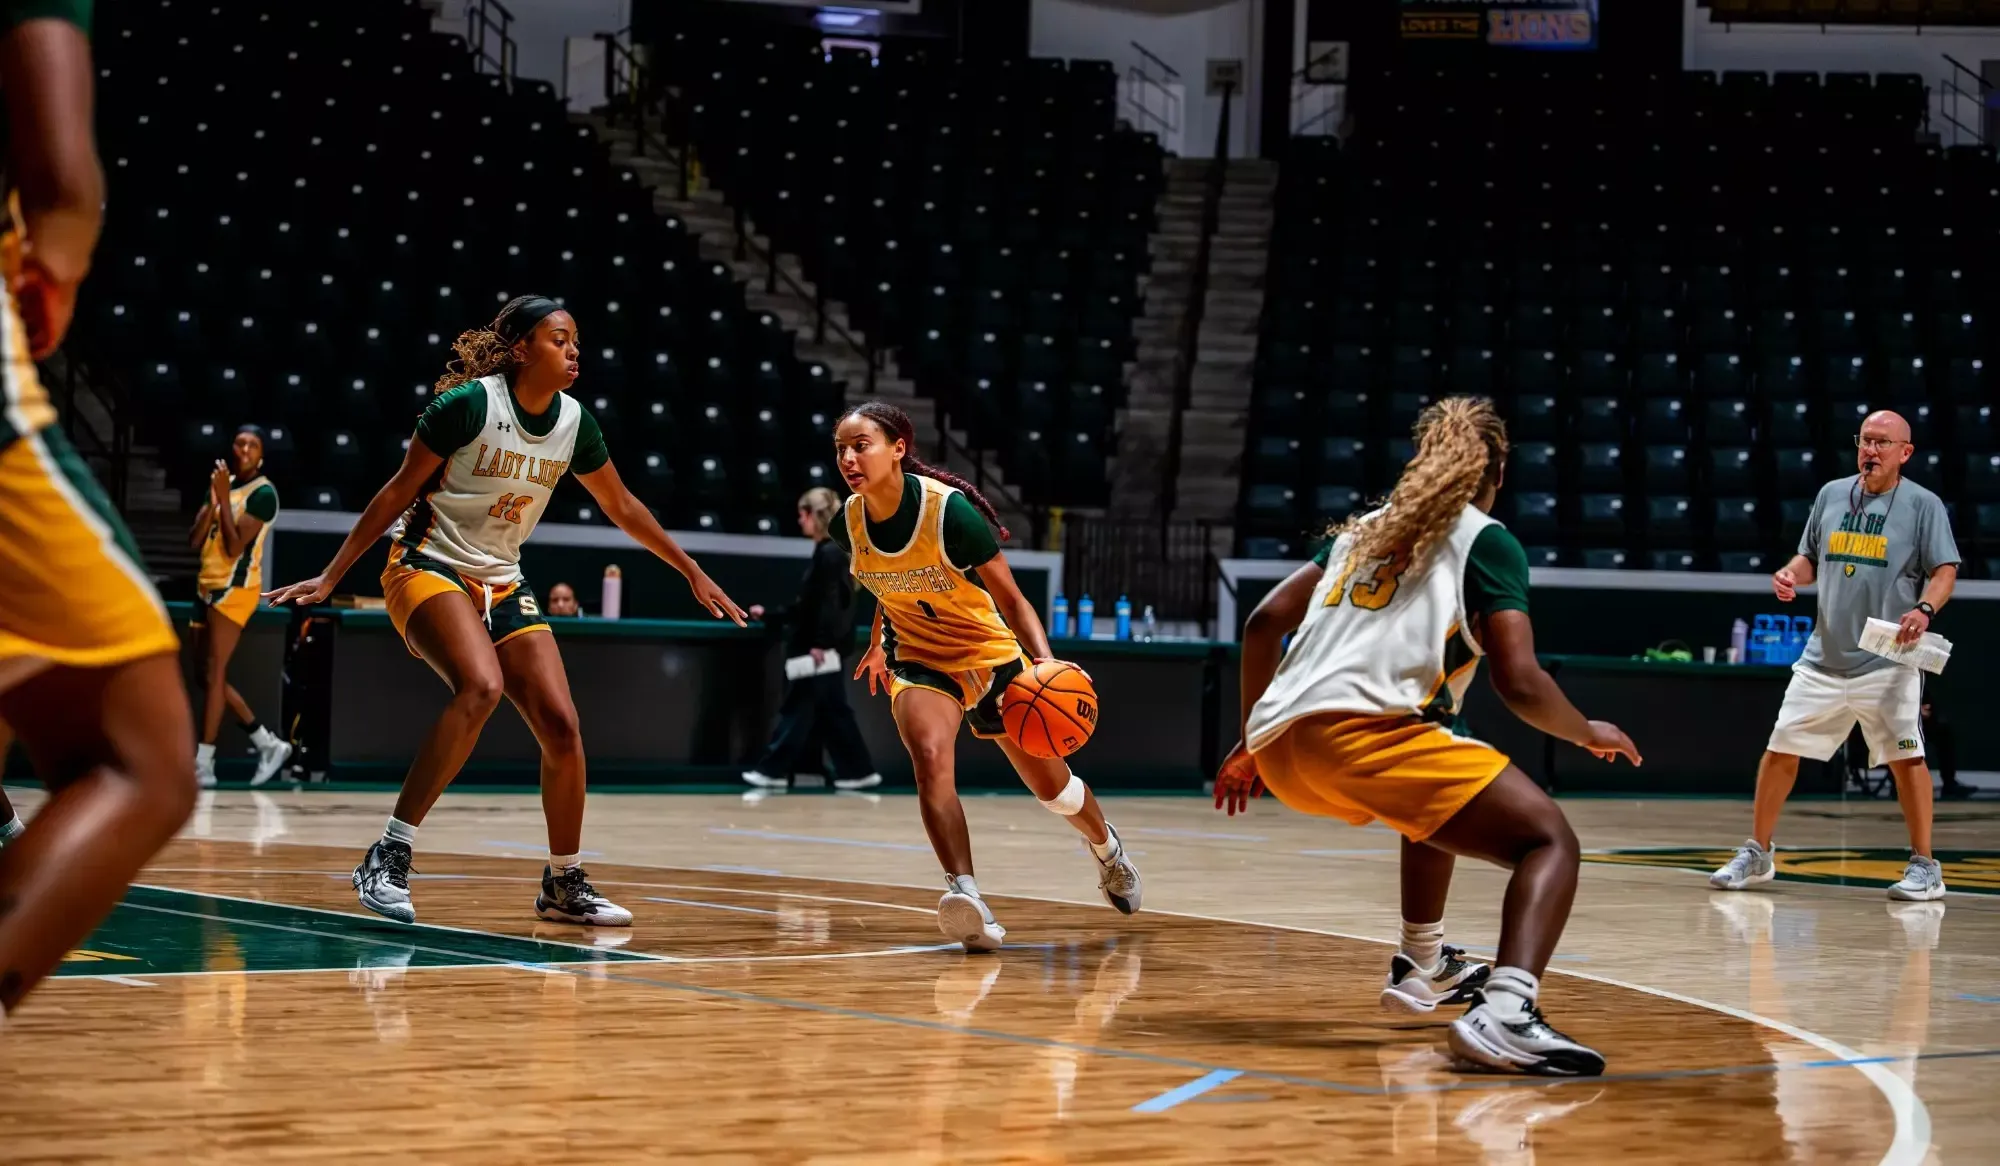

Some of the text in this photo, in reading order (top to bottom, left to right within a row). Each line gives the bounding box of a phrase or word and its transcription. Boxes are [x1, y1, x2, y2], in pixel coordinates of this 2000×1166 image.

[1491, 12, 1590, 42] LIONS
[471, 443, 527, 480] LADY
[1839, 511, 1863, 533] ALL
[1828, 531, 1889, 560] NOTHING
[1322, 549, 1407, 611] 13
[916, 599, 939, 618] 1
